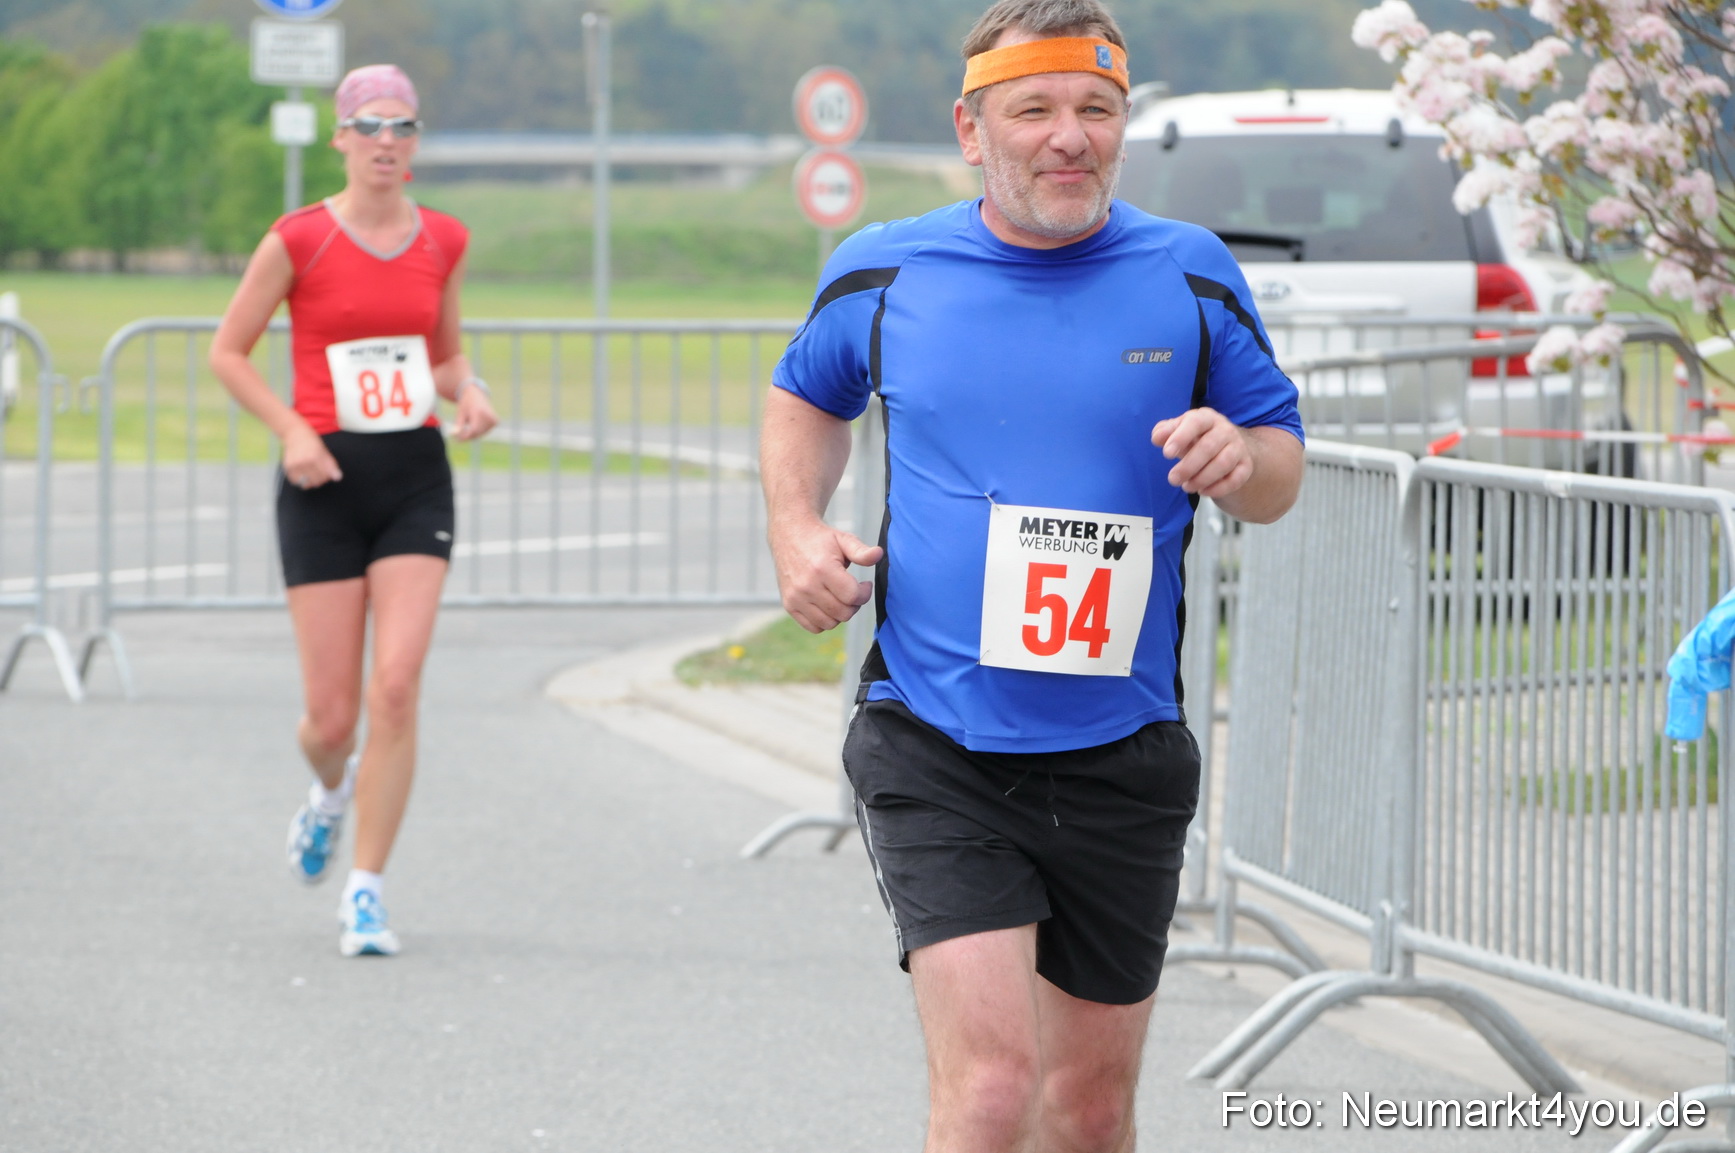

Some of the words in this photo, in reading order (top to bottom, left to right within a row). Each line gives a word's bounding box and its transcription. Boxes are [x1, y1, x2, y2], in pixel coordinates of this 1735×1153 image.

[358, 370, 412, 419] 84
[1018, 535, 1098, 555] WERBUNG
[1019, 516, 1099, 540] MEYER
[1021, 561, 1112, 659] 54
